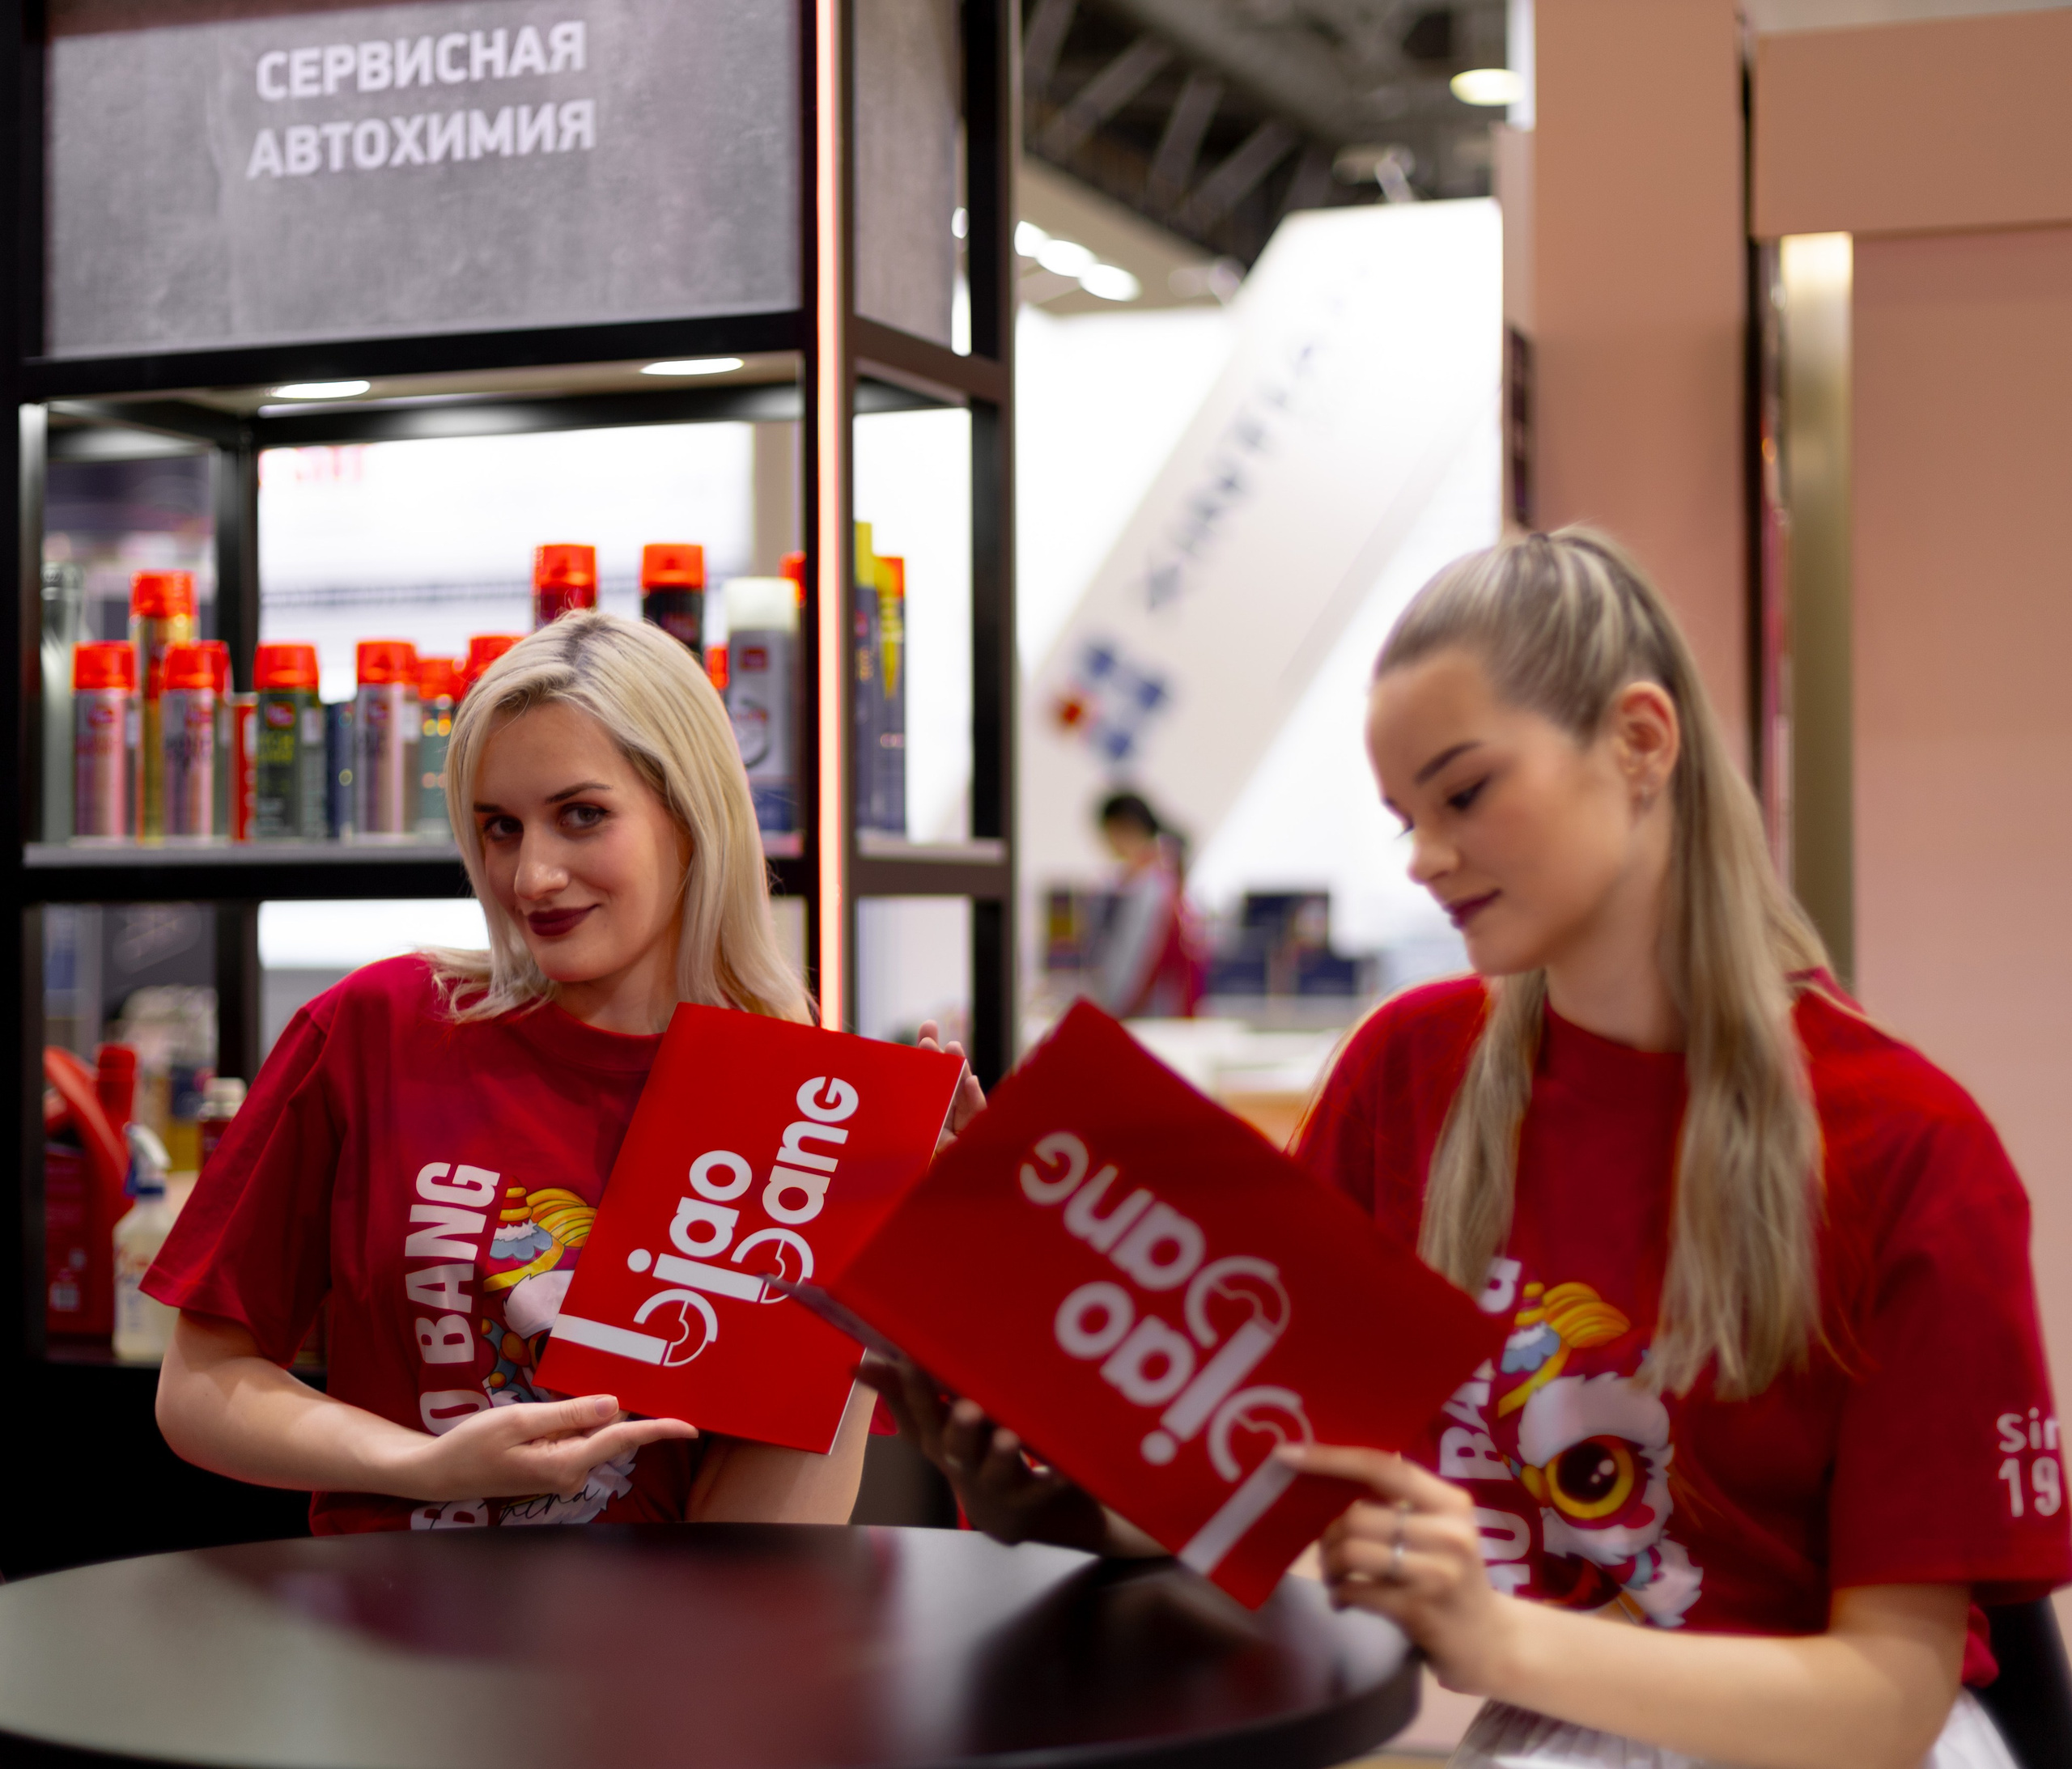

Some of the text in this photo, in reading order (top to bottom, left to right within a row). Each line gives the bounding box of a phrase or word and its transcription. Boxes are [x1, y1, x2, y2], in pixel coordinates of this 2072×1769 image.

[257, 20, 586, 101] СЕРВИСНАЯ
[246, 98, 596, 180] АВТОХИМИЯ
[405, 1162, 500, 1364] BANG
